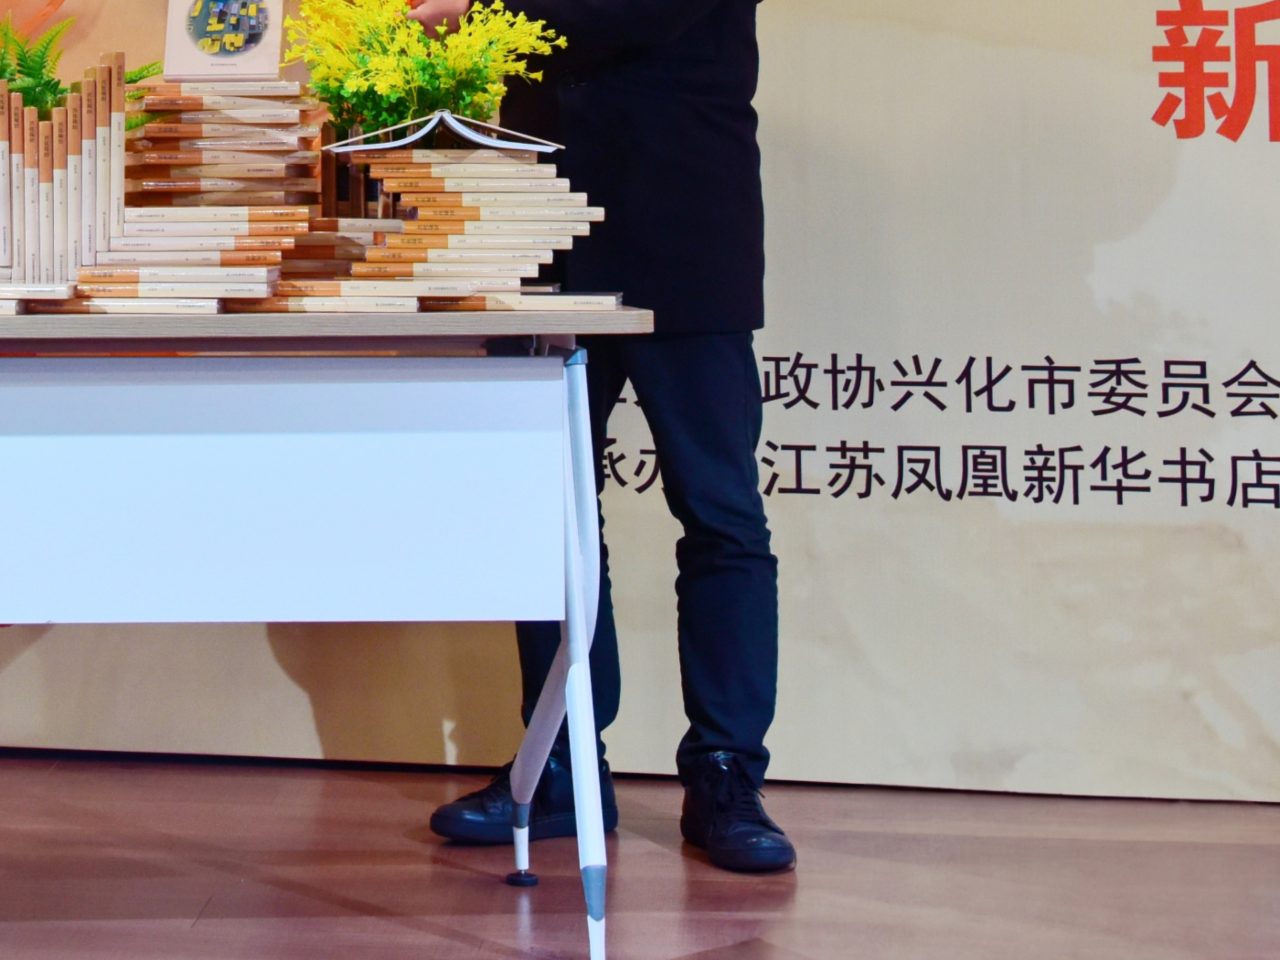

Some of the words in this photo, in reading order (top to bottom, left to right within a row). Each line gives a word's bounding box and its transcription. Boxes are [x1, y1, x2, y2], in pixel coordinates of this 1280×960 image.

[762, 351, 1280, 420] 政协兴化市委员会
[760, 439, 1280, 511] 江苏凤凰新华书店
